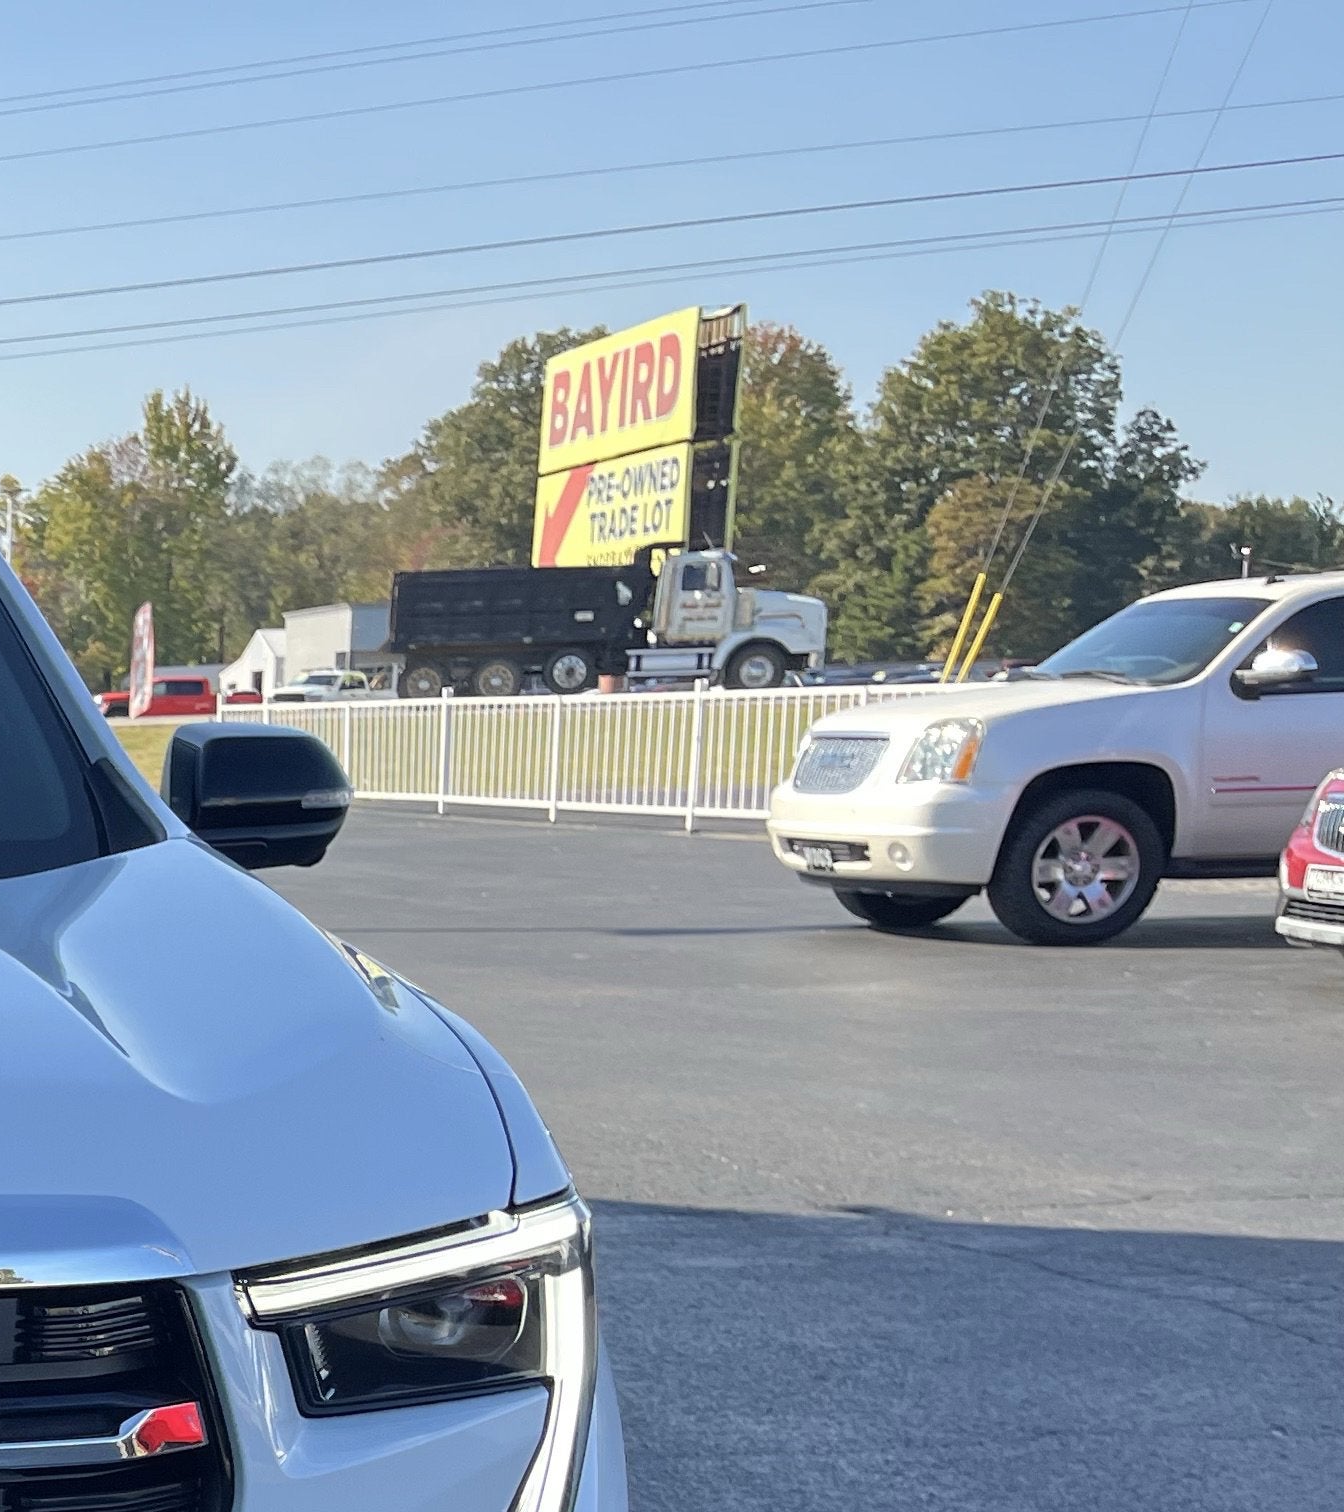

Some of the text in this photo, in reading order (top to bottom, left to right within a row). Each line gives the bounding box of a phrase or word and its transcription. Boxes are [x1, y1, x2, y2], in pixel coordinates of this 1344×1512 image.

[549, 333, 681, 448] BAYIRD
[587, 457, 680, 507] PRE-OWNED
[590, 498, 673, 545] TRADE LOT
